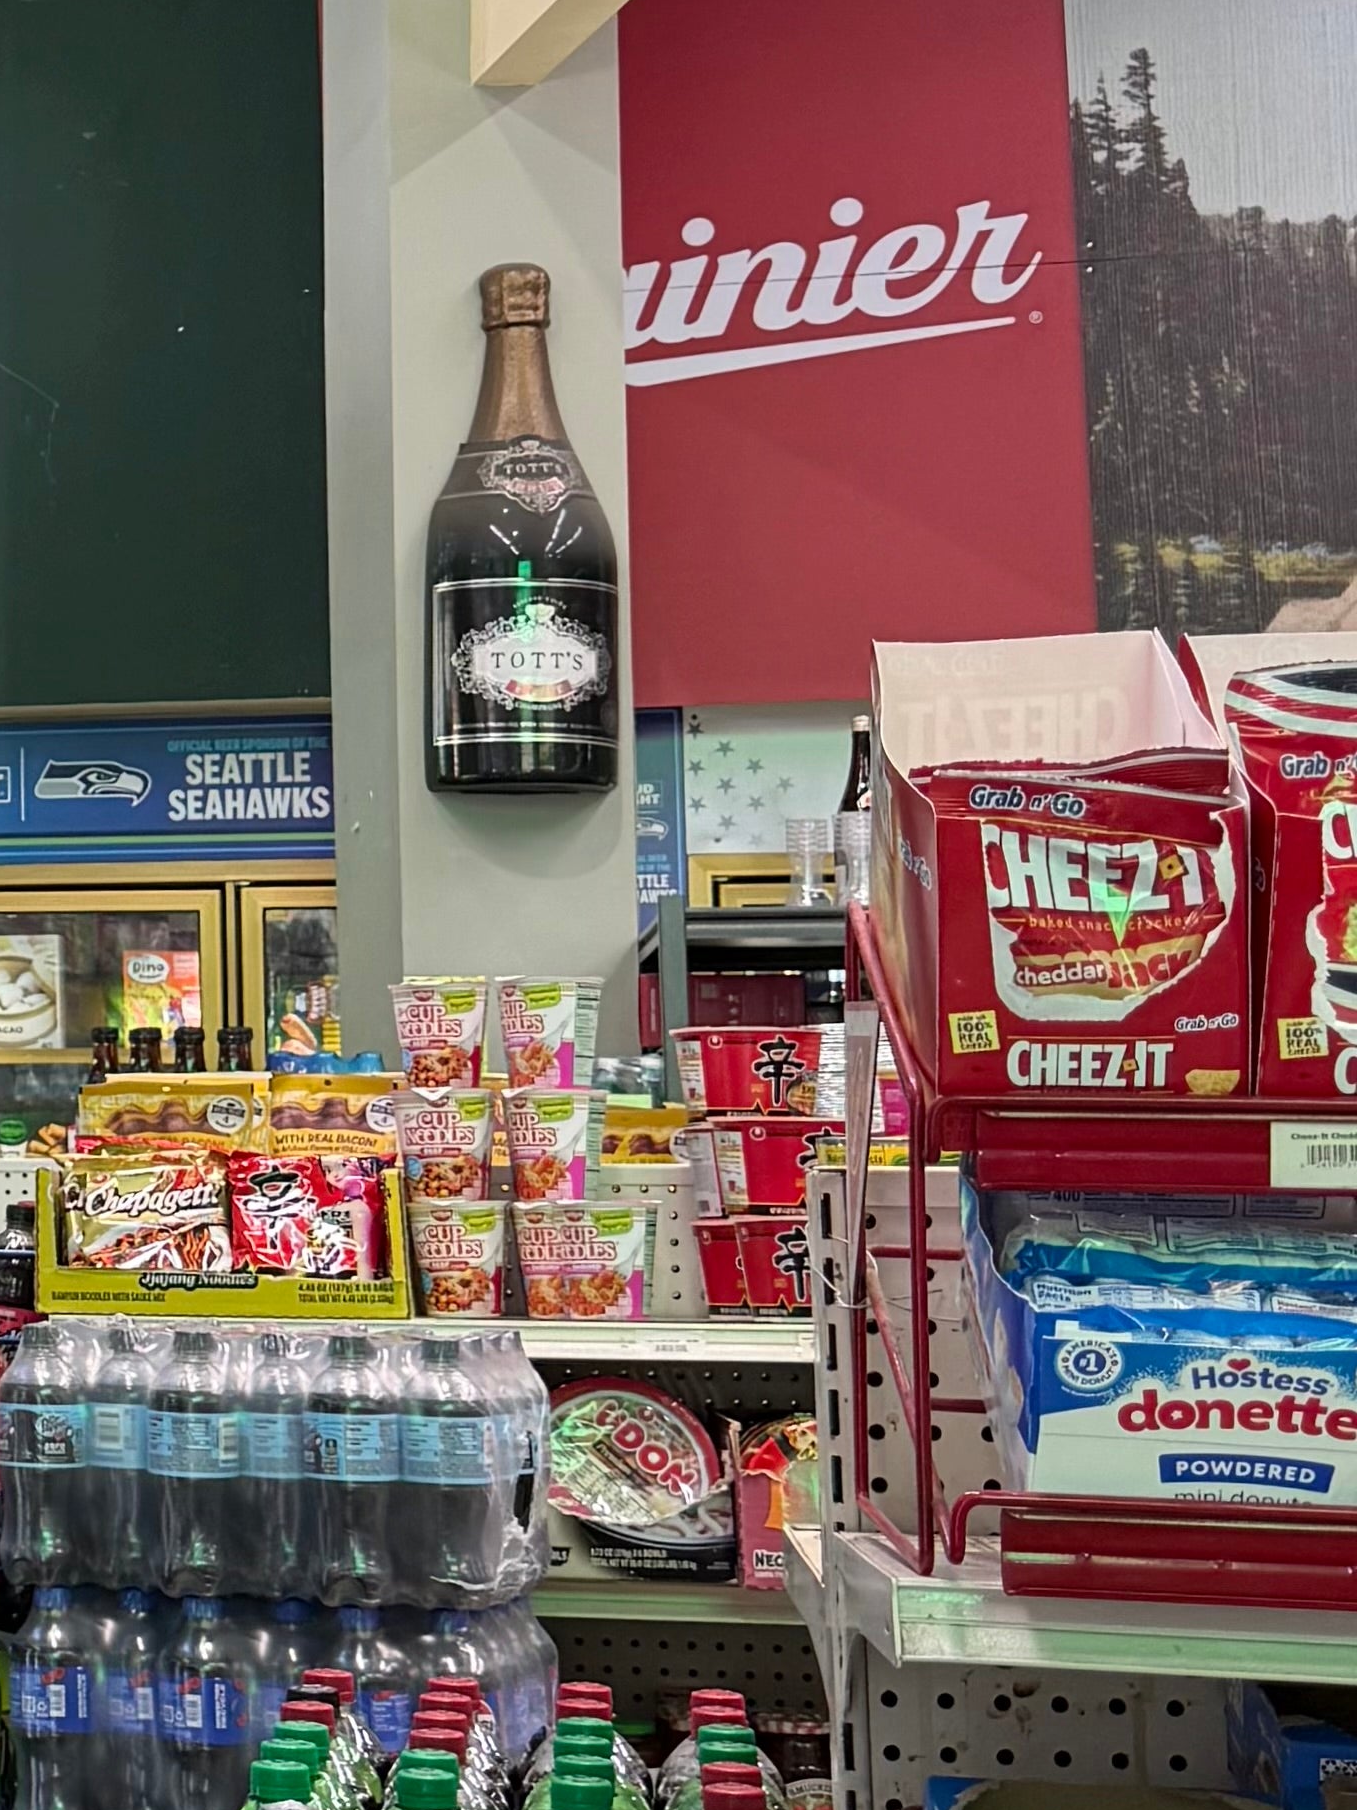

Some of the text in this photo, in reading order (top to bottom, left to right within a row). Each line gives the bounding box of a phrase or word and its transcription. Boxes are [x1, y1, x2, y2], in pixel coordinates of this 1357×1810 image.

[503, 462, 563, 475] TOTT'S
[491, 651, 584, 671] TOTT'S
[186, 753, 310, 785] SEATTLE
[1281, 754, 1328, 778] Grab
[168, 788, 330, 821] SEAHAWKS
[970, 786, 1084, 819] Grab Go
[1029, 914, 1072, 929] baked
[132, 961, 165, 975] Dino
[1016, 959, 1108, 986] cheddar
[406, 1006, 446, 1023] CUP
[1175, 1013, 1239, 1032] Grab Go
[956, 1021, 993, 1034] 100%
[958, 1033, 989, 1043] REAL
[751, 1034, 805, 1106] 辛
[418, 1112, 461, 1128] CUP
[276, 1134, 305, 1146] WITH
[308, 1133, 333, 1145] REAL
[406, 1127, 474, 1145] NOODLES
[425, 1225, 466, 1242] CUP
[561, 1226, 598, 1243] CUP
[1064, 1340, 1117, 1361] AMERICA'S
[1193, 1365, 1330, 1396] Hostess
[1176, 1460, 1316, 1484] POWDERED
